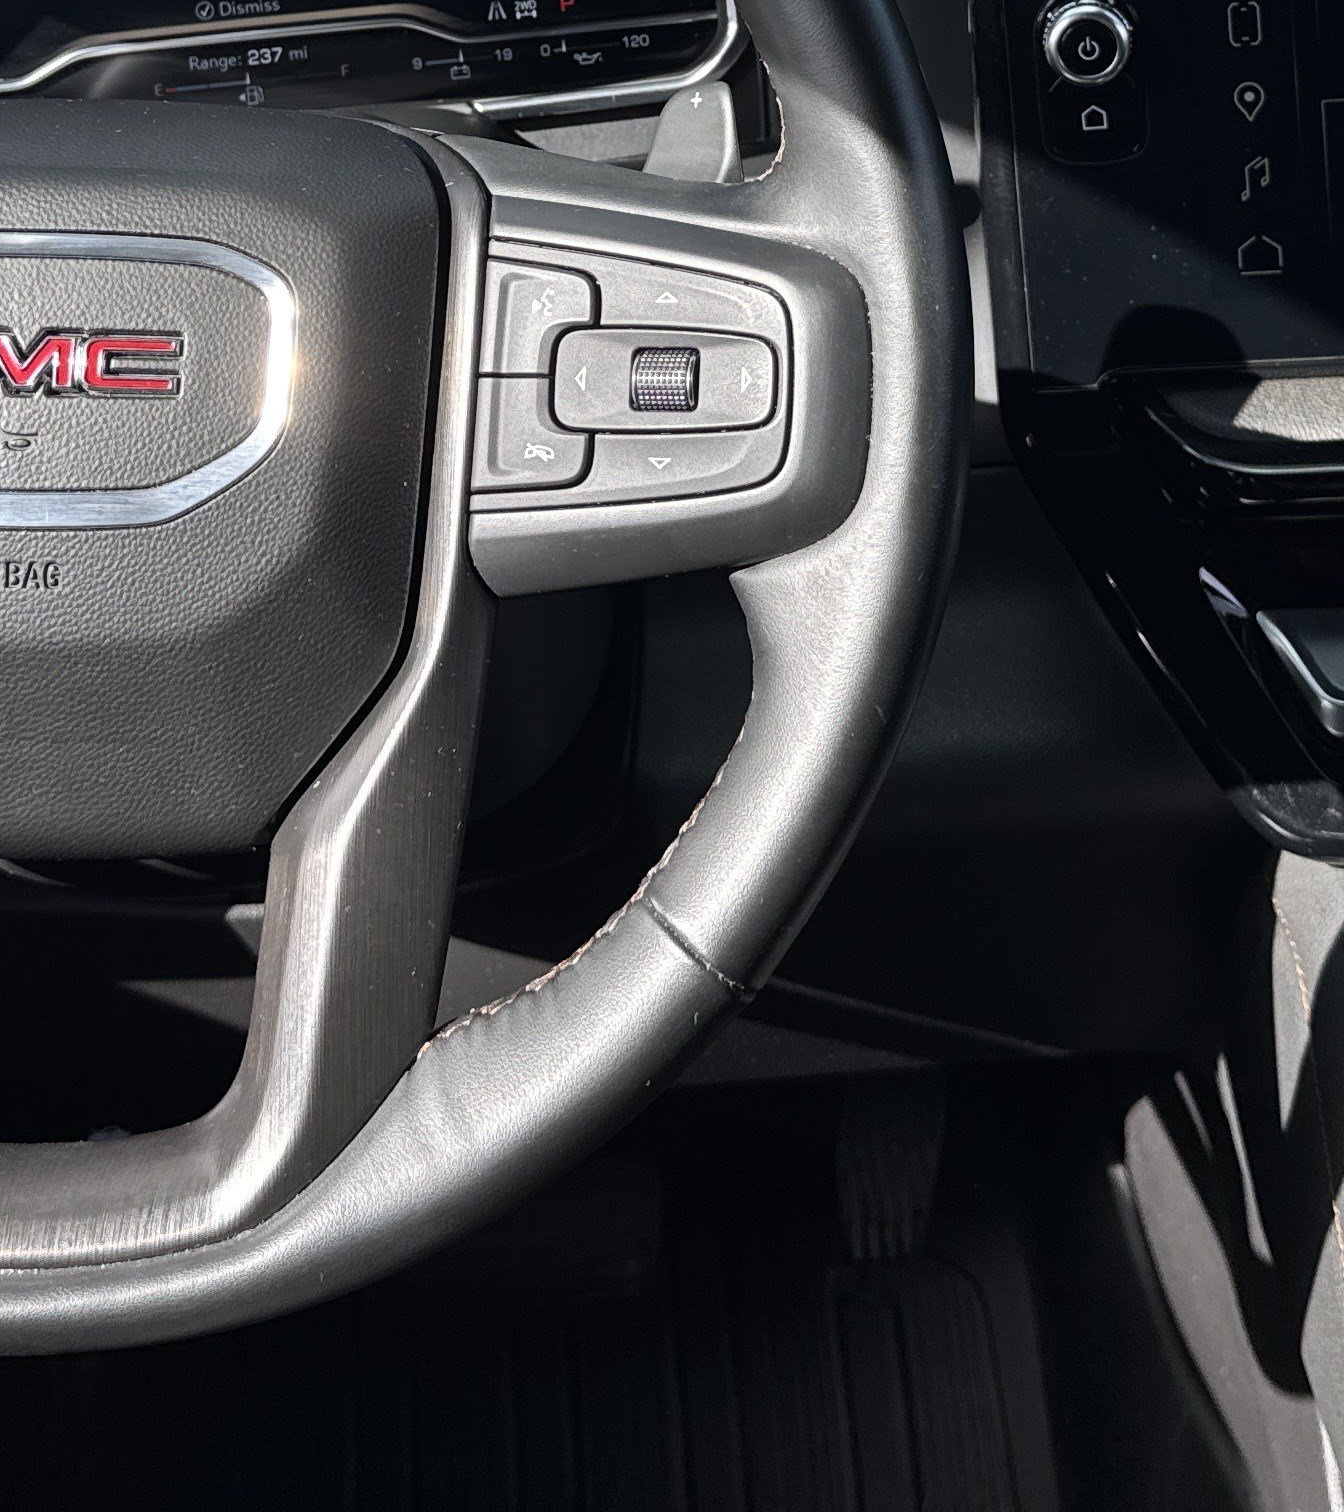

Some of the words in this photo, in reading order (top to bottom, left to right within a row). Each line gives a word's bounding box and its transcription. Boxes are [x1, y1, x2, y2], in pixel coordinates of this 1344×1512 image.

[621, 34, 650, 49] 120
[189, 51, 243, 73] Range:
[247, 46, 283, 67] 237
[289, 46, 309, 62] mi
